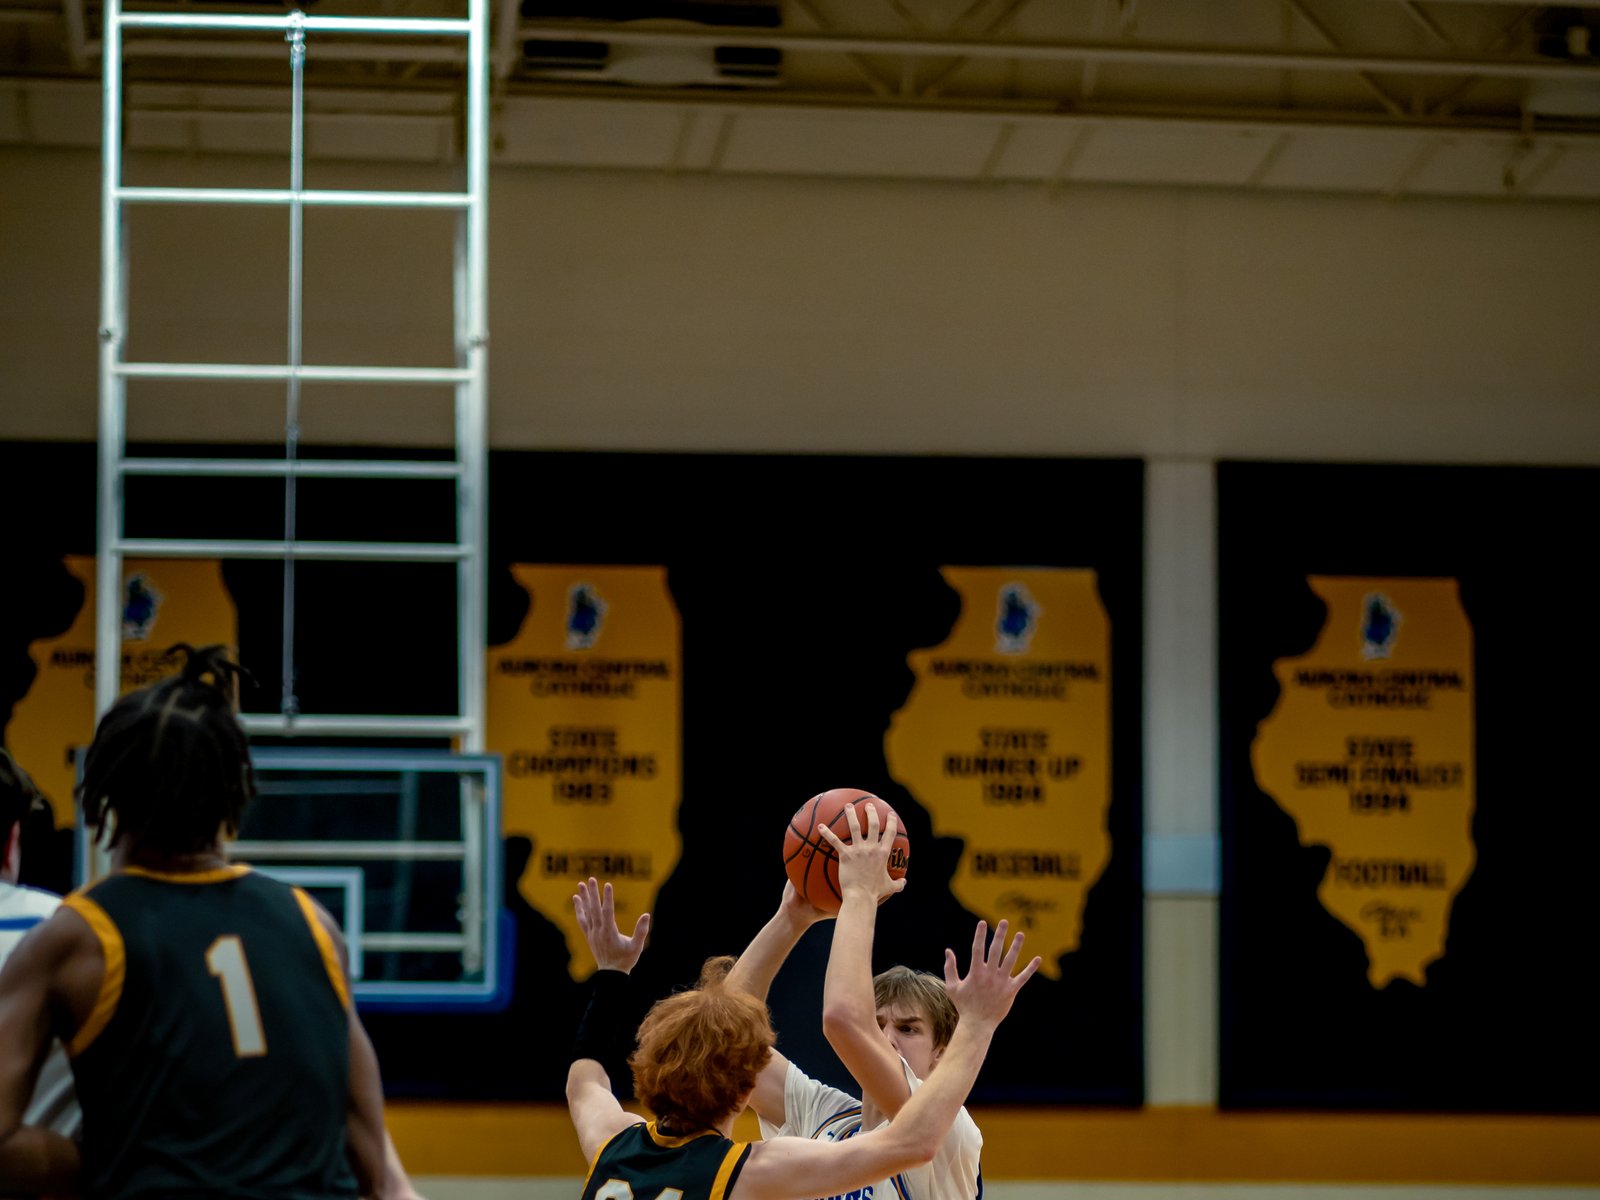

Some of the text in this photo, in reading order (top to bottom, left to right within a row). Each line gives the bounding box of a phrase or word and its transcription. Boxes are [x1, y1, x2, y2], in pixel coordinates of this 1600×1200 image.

[549, 728, 616, 750] STATE
[980, 729, 1048, 751] STATE
[1347, 738, 1413, 760] STATE
[508, 753, 657, 778] CHAMPIONS
[943, 755, 1081, 780] RUNNER UP
[541, 851, 650, 879] BASEBALL
[971, 852, 1081, 880] BASEBALL
[1334, 862, 1446, 890] FOOTBALL
[204, 934, 269, 1058] 1
